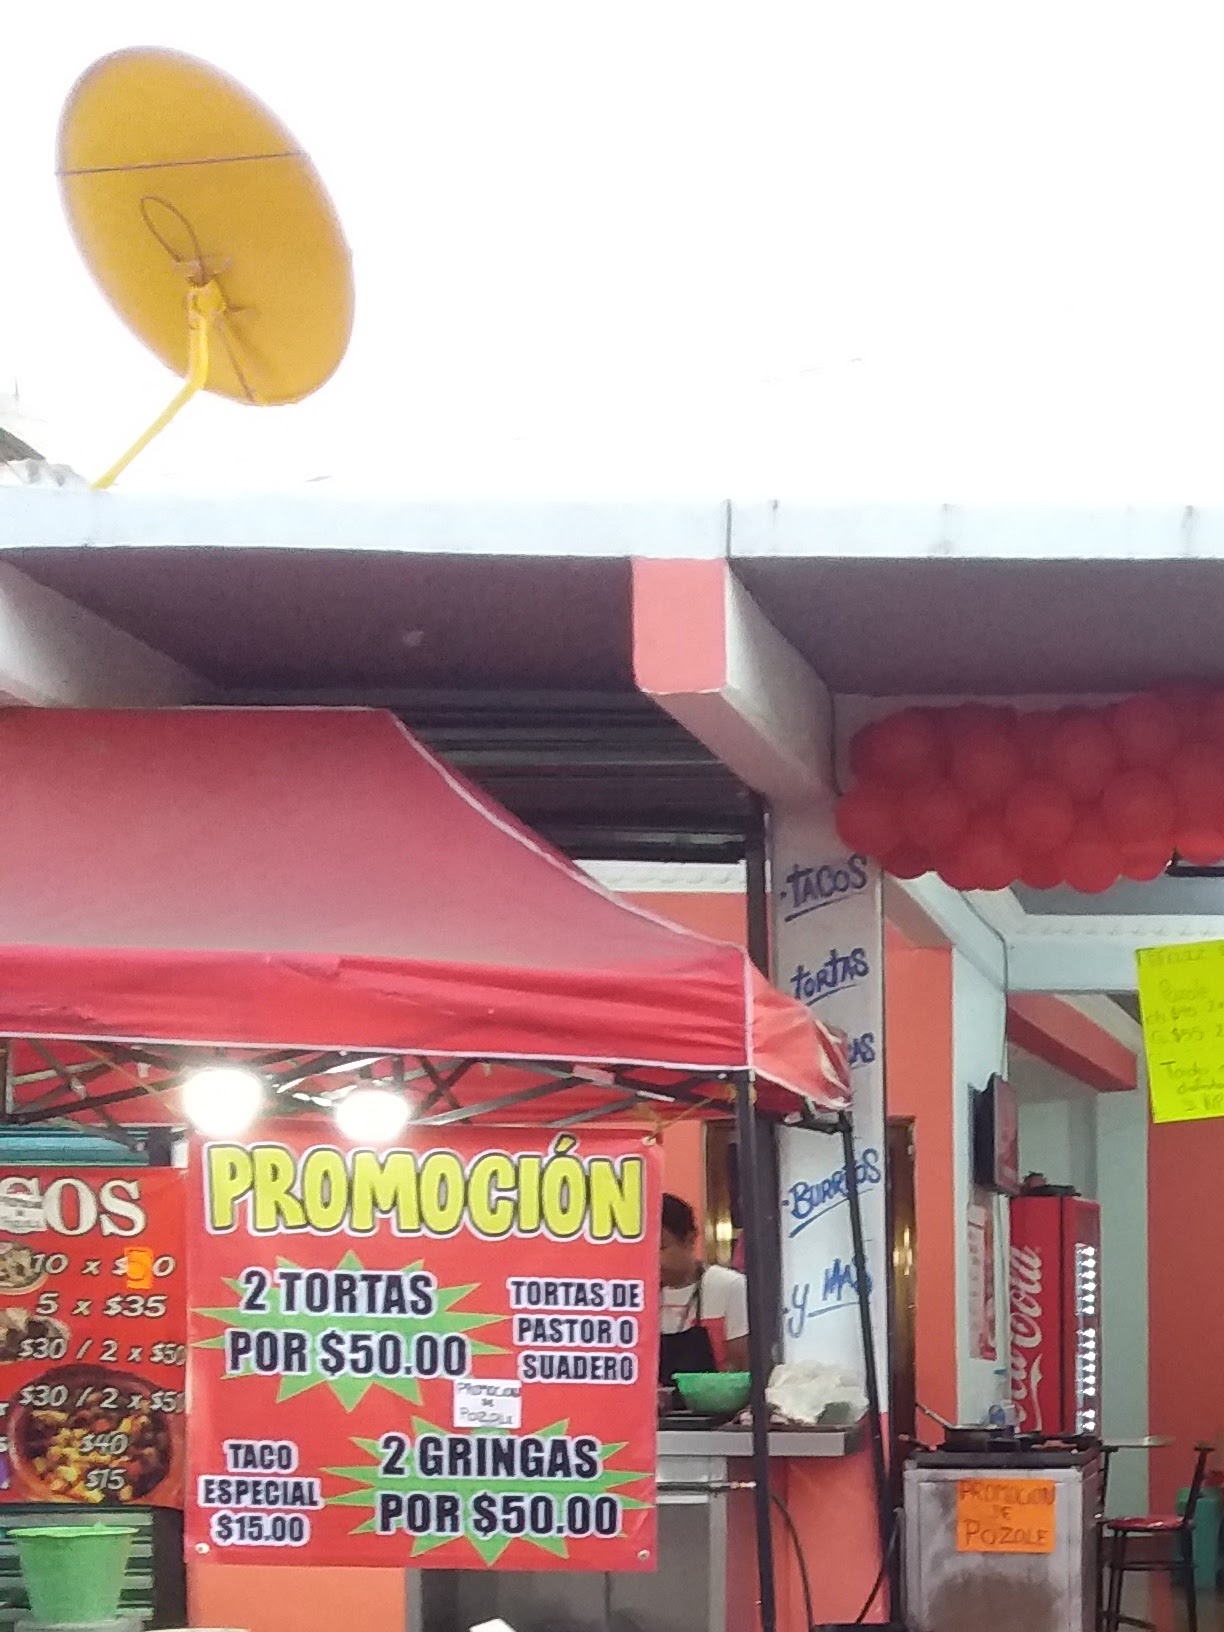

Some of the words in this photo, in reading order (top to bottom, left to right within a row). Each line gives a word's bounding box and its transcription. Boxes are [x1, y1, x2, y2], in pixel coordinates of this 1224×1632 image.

[206, 1133, 645, 1241] PROMOCIÓN
[31, 1253, 69, 1276] 10
[36, 1291, 60, 1316] 5
[103, 1294, 169, 1318] $35
[243, 1269, 269, 1312] 2
[279, 1271, 435, 1317] TORTAS
[510, 1279, 605, 1309] TORTAS
[611, 1282, 642, 1309] DE
[517, 1315, 613, 1346] PASTOR
[619, 1318, 635, 1346] O
[17, 1337, 68, 1361] $30
[99, 1339, 119, 1363] 2
[228, 1329, 308, 1374] POR
[319, 1328, 469, 1378] $50.00
[521, 1352, 635, 1384] SUADERO
[18, 1384, 70, 1408] $30
[99, 1387, 121, 1410] 2
[228, 1443, 293, 1470] TACO
[382, 1436, 406, 1476] 2
[419, 1436, 598, 1479] GRINGAS
[203, 1478, 320, 1507] ESPECIAL
[214, 1513, 305, 1542] $15.00
[380, 1493, 460, 1534] POR
[472, 1491, 618, 1537] $50.00
